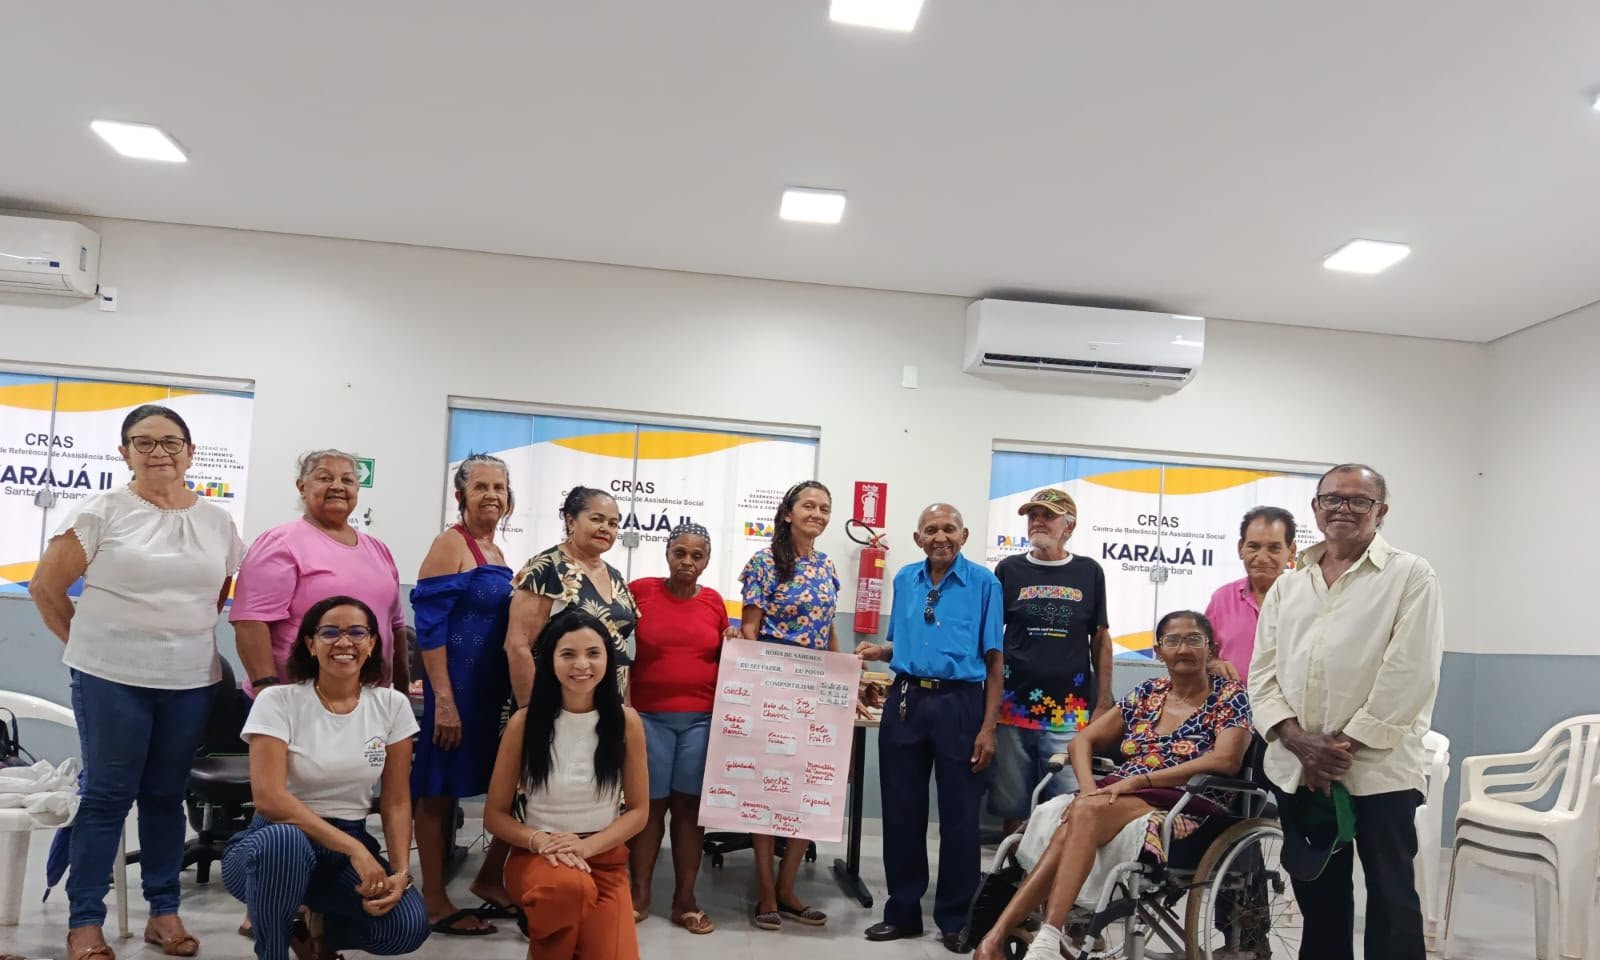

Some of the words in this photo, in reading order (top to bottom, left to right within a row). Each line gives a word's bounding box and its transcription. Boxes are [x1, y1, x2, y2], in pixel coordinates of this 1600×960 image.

[25, 433, 74, 448] CRAS
[9, 448, 48, 456] Referência
[62, 451, 104, 460] Assistência
[105, 454, 124, 462] Socia
[0, 463, 91, 489] ARAJÁ
[99, 472, 113, 490] II
[611, 480, 655, 494] CRAS
[644, 497, 682, 505] Assistência
[1137, 514, 1179, 528] CRAS
[1092, 525, 1113, 533] Centro
[1124, 527, 1157, 535] Referência
[1169, 530, 1205, 539] Assistência
[997, 535, 1030, 548] PALM
[1102, 541, 1195, 565] KARAJÁ
[1202, 549, 1213, 566] II
[1122, 562, 1150, 573] Santa
[1017, 585, 1083, 602] AUTISMO
[810, 724, 828, 733] Bolo
